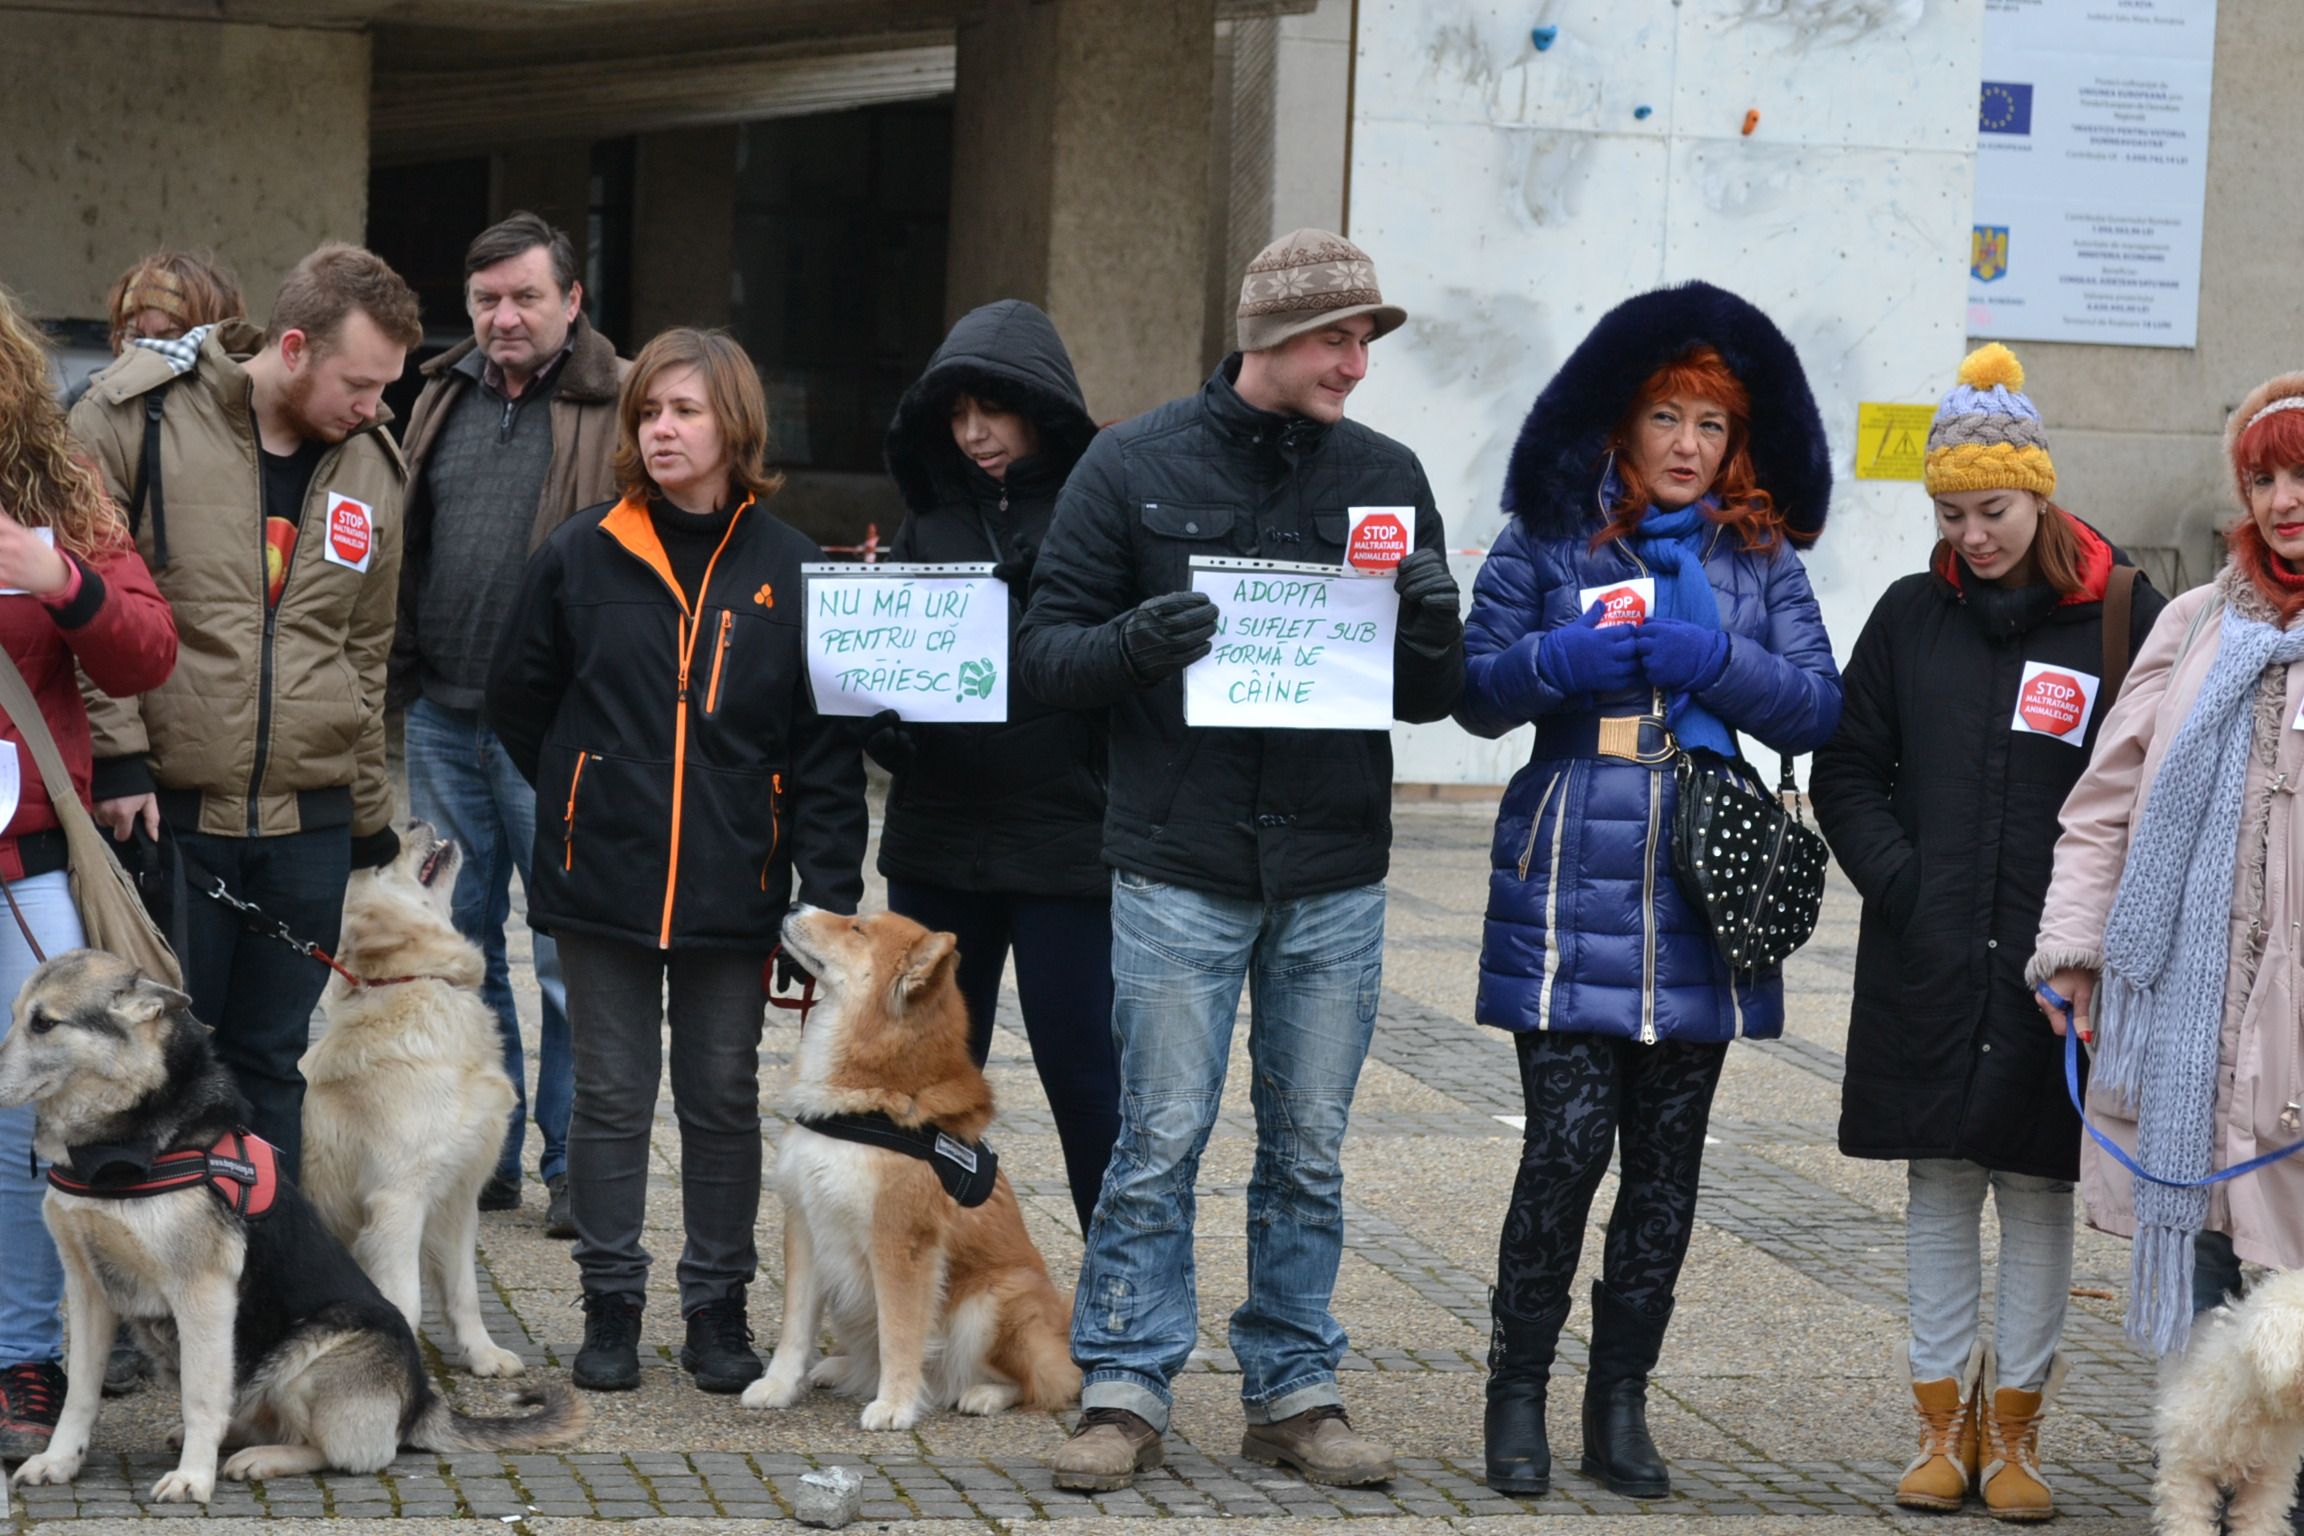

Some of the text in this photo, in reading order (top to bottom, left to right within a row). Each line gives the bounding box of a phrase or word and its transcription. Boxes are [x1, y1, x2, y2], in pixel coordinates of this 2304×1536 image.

[339, 510, 364, 528] STOP
[1363, 525, 1398, 540] STOP
[1354, 541, 1404, 550] MALTRATAREA
[1353, 552, 1401, 560] ANIMALELOR
[820, 588, 861, 617] NU
[1606, 596, 1633, 612] TOP
[820, 622, 959, 655] PENTRU CĂ
[1215, 616, 1378, 643] N SUFLET SUB
[1294, 645, 1326, 667] DE
[2036, 681, 2076, 701] STOP
[2025, 705, 2074, 723] ANIMALELOR
[2026, 695, 2080, 715] MALTRATAREA
